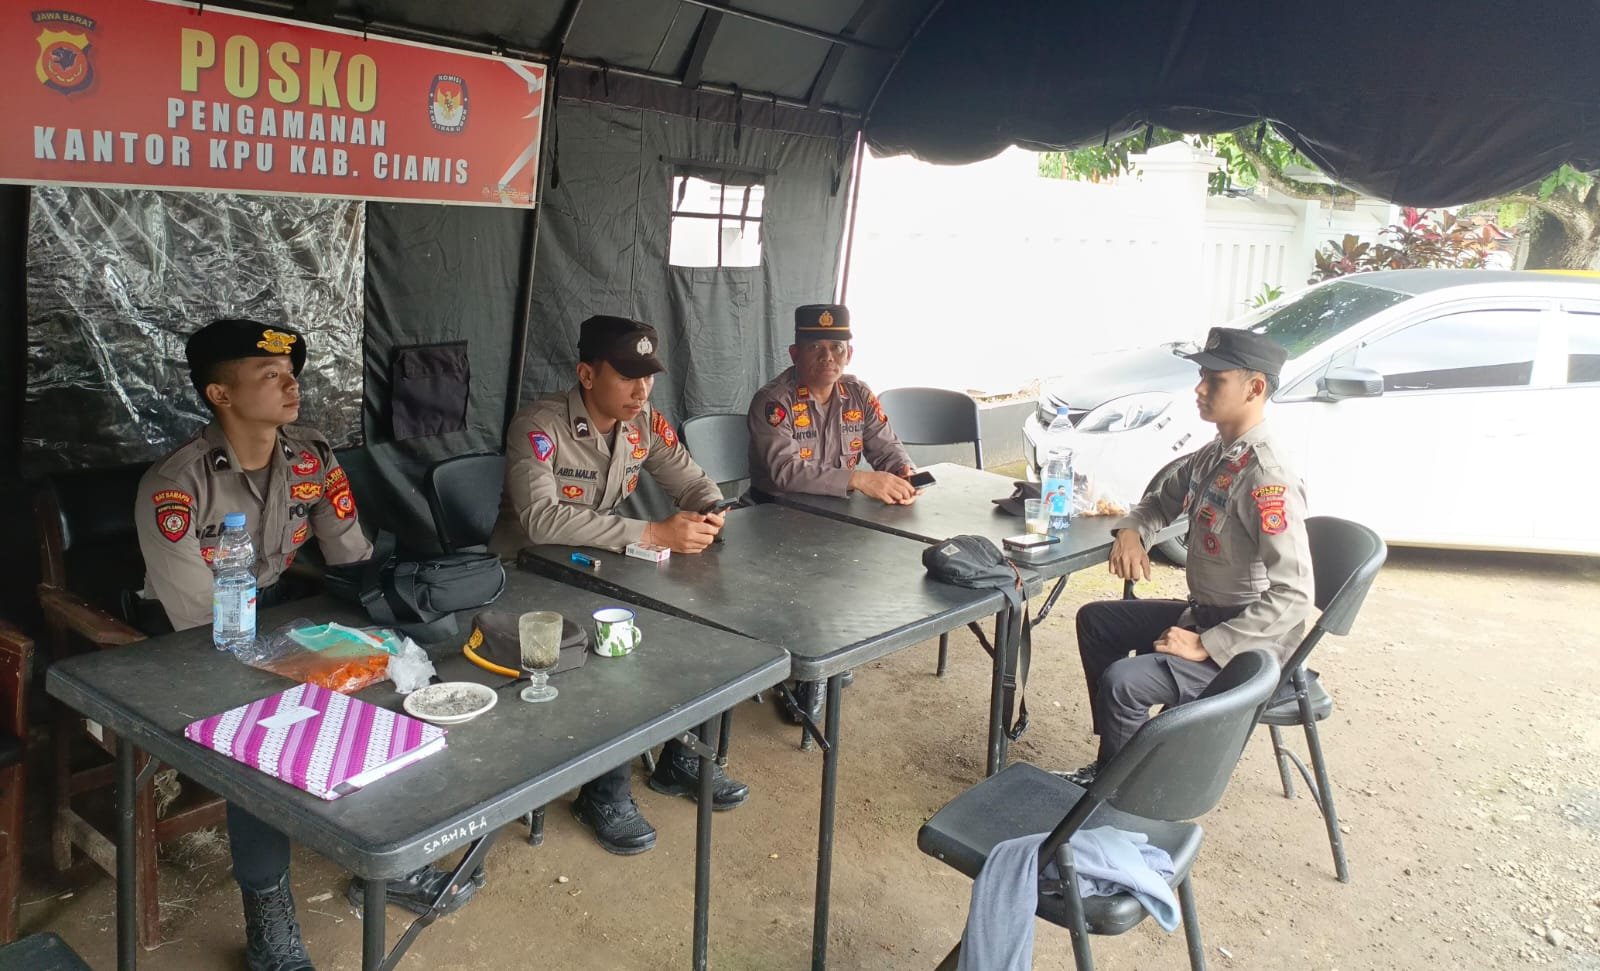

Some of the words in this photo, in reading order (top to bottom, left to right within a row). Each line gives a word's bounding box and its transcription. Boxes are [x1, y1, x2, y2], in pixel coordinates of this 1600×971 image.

[36, 12, 61, 21] JAWA
[63, 13, 93, 28] BARAT
[181, 27, 377, 112] POSKO
[438, 75, 462, 84] KOMISI
[167, 97, 385, 146] PENGAMANAN
[33, 126, 190, 167] KANTOR
[209, 138, 273, 172] KPU
[290, 145, 359, 177] KAB.
[373, 152, 468, 184] CIAMIS
[423, 816, 488, 855] SABHARA
